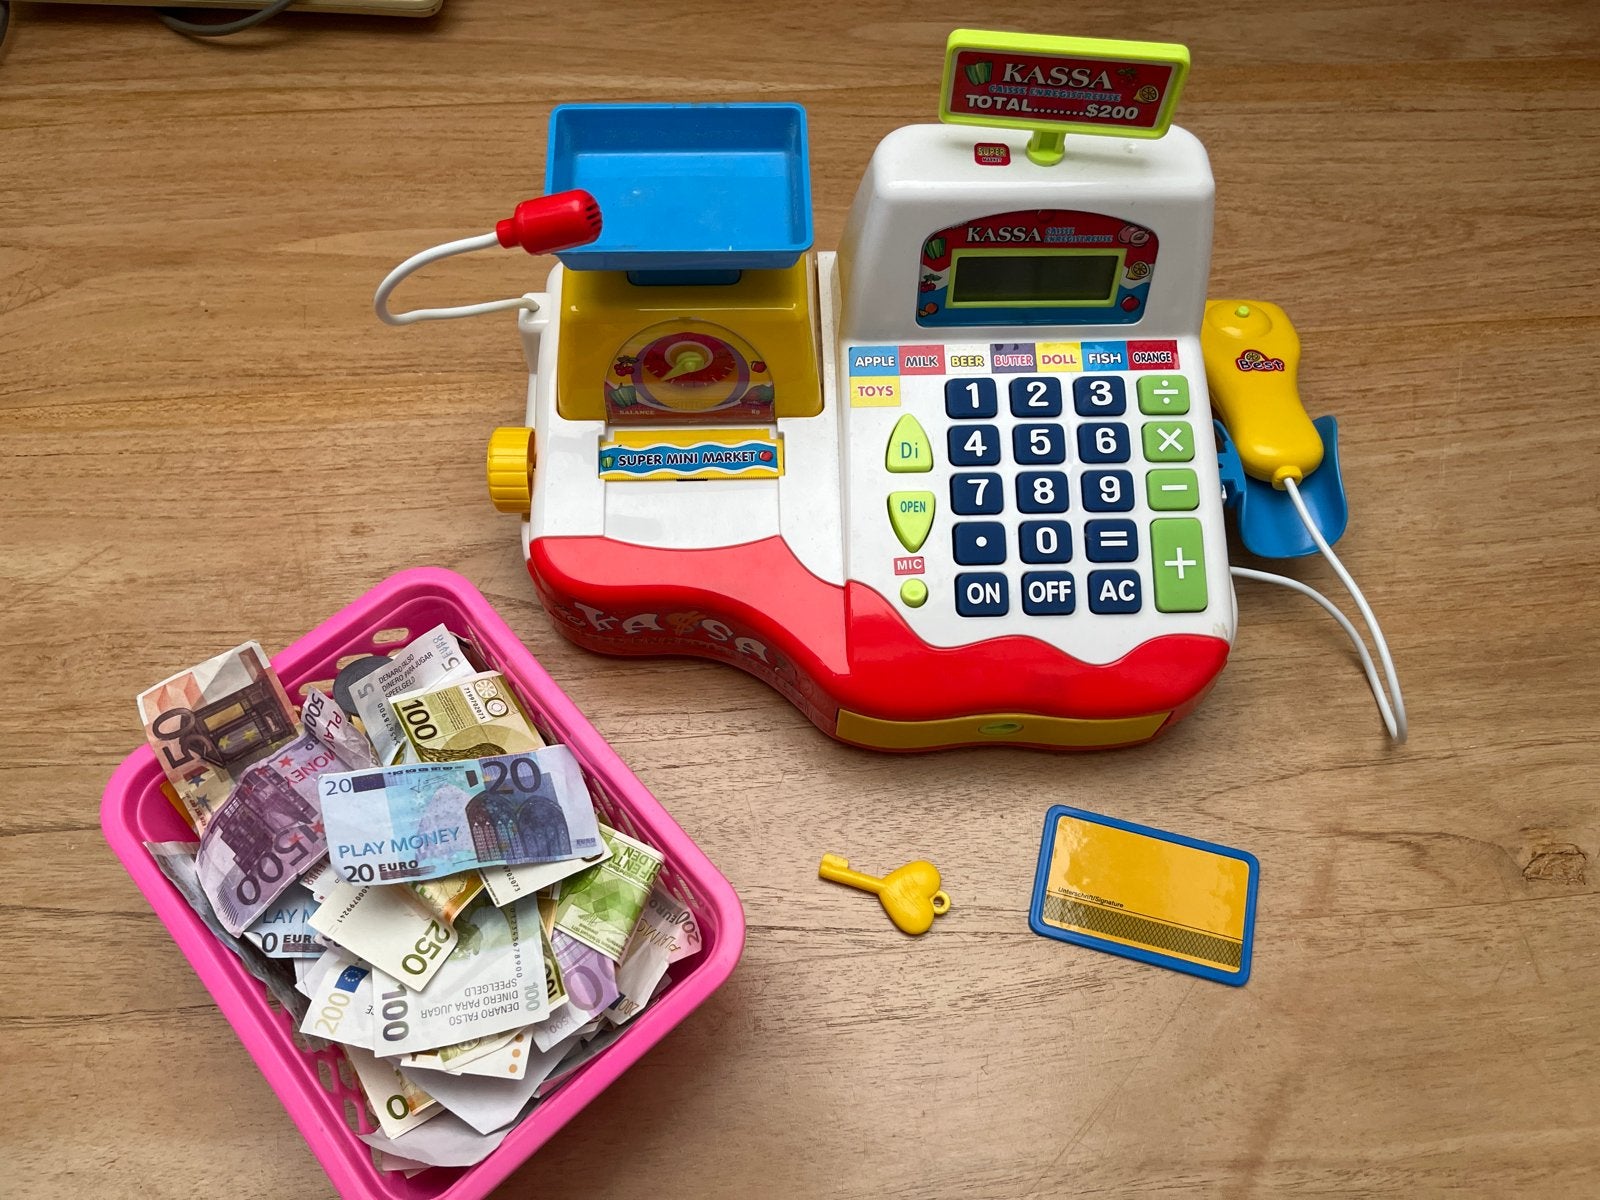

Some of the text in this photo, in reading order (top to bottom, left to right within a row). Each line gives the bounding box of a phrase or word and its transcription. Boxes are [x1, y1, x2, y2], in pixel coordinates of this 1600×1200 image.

[1002, 63, 1113, 91] KASSA
[978, 147, 1006, 157] SUPER
[966, 226, 1042, 242] KASSA
[855, 351, 1173, 367] APPLE MILK BEER BUTTER DOLL FISH ORANGE
[1238, 359, 1284, 370] Best
[858, 385, 893, 397] TOYS
[965, 382, 980, 409] 1
[1026, 381, 1050, 407] 2
[1089, 380, 1113, 406] 3
[901, 442, 918, 459] Di
[963, 430, 988, 456] 4
[1030, 429, 1051, 455] 5
[1095, 427, 1117, 454] 6
[618, 451, 757, 467] SUPER MINI MARKET
[967, 479, 989, 506] 7
[1033, 477, 1055, 504] 8
[1099, 476, 1121, 503] 9
[900, 501, 926, 513] OPEN
[1036, 527, 1057, 554] 0
[897, 558, 922, 570] MIC
[966, 579, 1136, 604] ON OFF AC
[378, 665, 403, 684] DENARO
[381, 674, 404, 692] DINERO
[415, 651, 434, 669] JUGAR
[303, 693, 324, 728] 500
[402, 699, 437, 740] 100
[152, 707, 196, 769] 50
[325, 778, 352, 796] 20
[483, 757, 541, 795] 20
[338, 827, 460, 859] PLAY MONEY
[343, 863, 375, 883] 20
[378, 860, 419, 872] EURO
[283, 934, 317, 943] EUR
[402, 919, 451, 976] 250
[464, 980, 518, 997] SPEELGELD
[525, 982, 540, 1012] 100
[314, 992, 351, 1036] 200
[381, 983, 409, 1042] 100
[420, 990, 519, 1019] DINERO PARA JUGAR
[448, 1001, 520, 1026] DENARO FALSO
